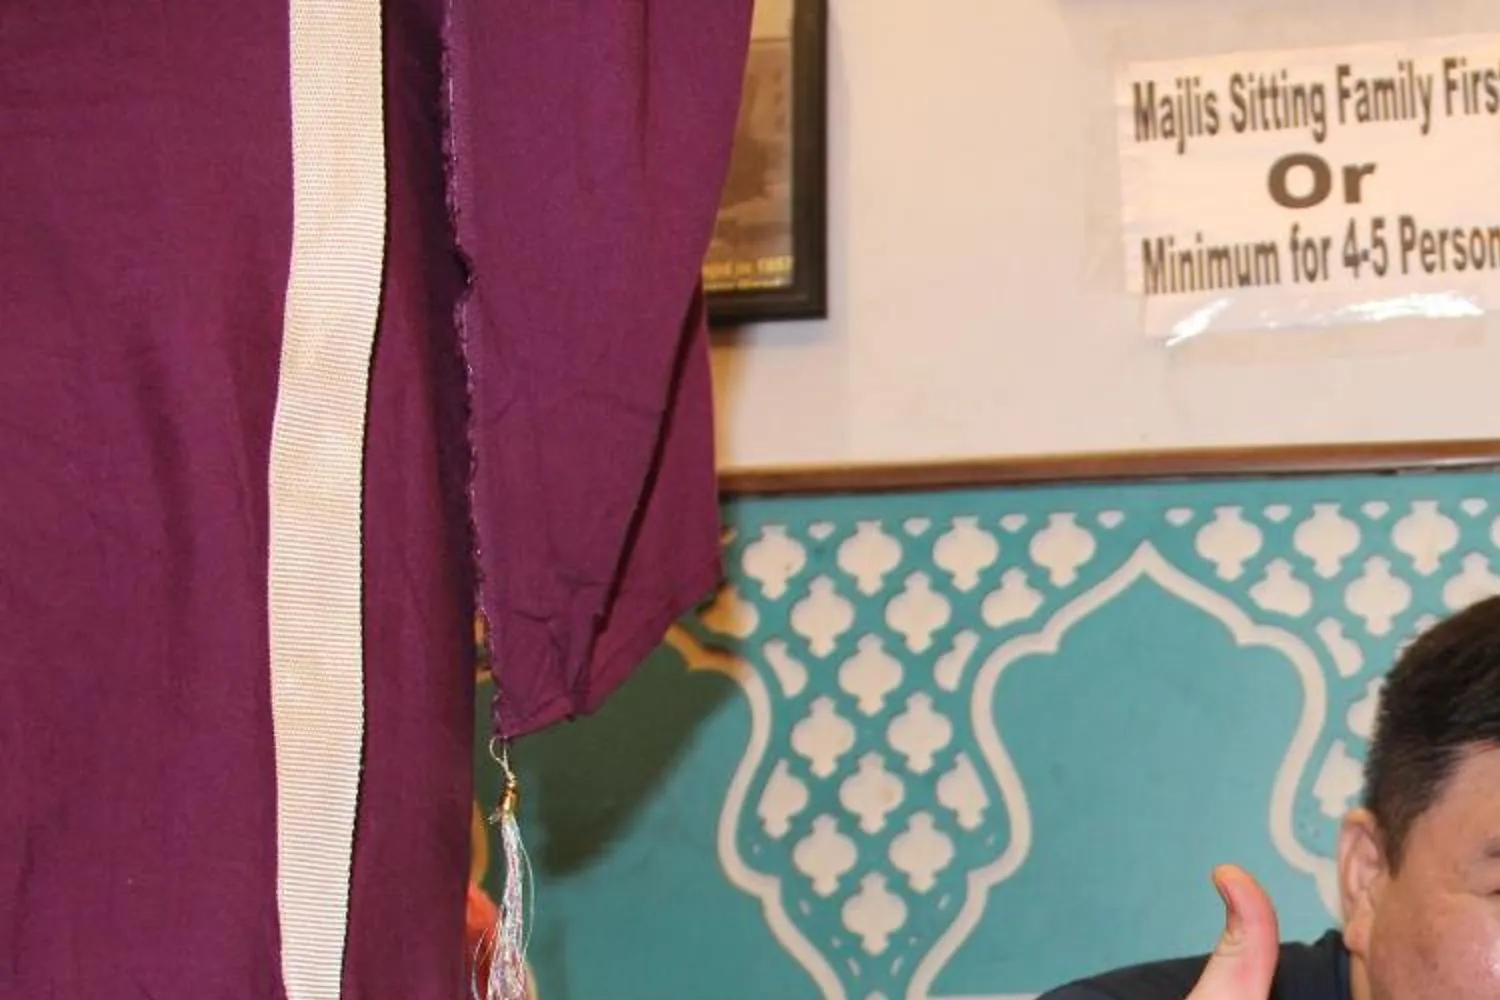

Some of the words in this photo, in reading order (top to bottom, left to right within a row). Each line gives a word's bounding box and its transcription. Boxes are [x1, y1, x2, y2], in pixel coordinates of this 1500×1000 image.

[1132, 75, 1221, 154] Majlis
[1229, 70, 1327, 143] Sitting
[1336, 60, 1433, 135] Family
[1268, 153, 1377, 209] Or
[1142, 233, 1280, 296] Minimum
[1291, 223, 1330, 284] for
[1342, 217, 1389, 278] 4-5
